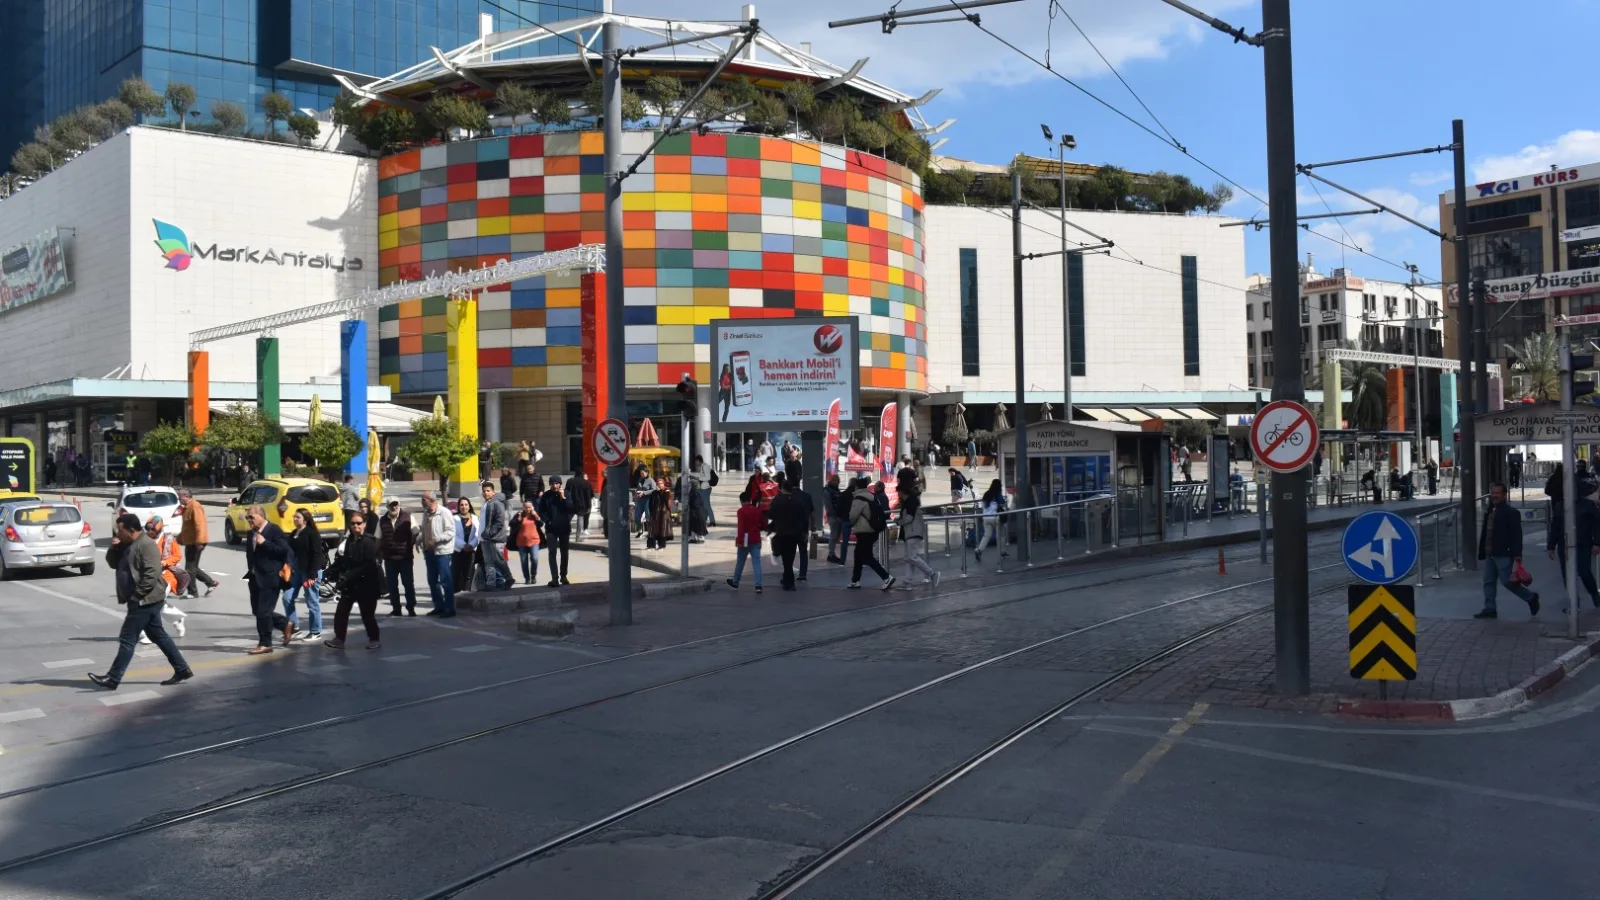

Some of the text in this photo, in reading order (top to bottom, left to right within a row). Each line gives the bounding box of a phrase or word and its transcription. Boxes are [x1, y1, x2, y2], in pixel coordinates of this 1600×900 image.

[1533, 169, 1579, 187] KURS
[190, 241, 363, 273] MarkAntalya
[759, 359, 804, 369] Bankkart
[763, 369, 837, 380] hemen indirin!
[1493, 418, 1519, 426] EXPO
[1049, 439, 1089, 448] ENTRANCE
